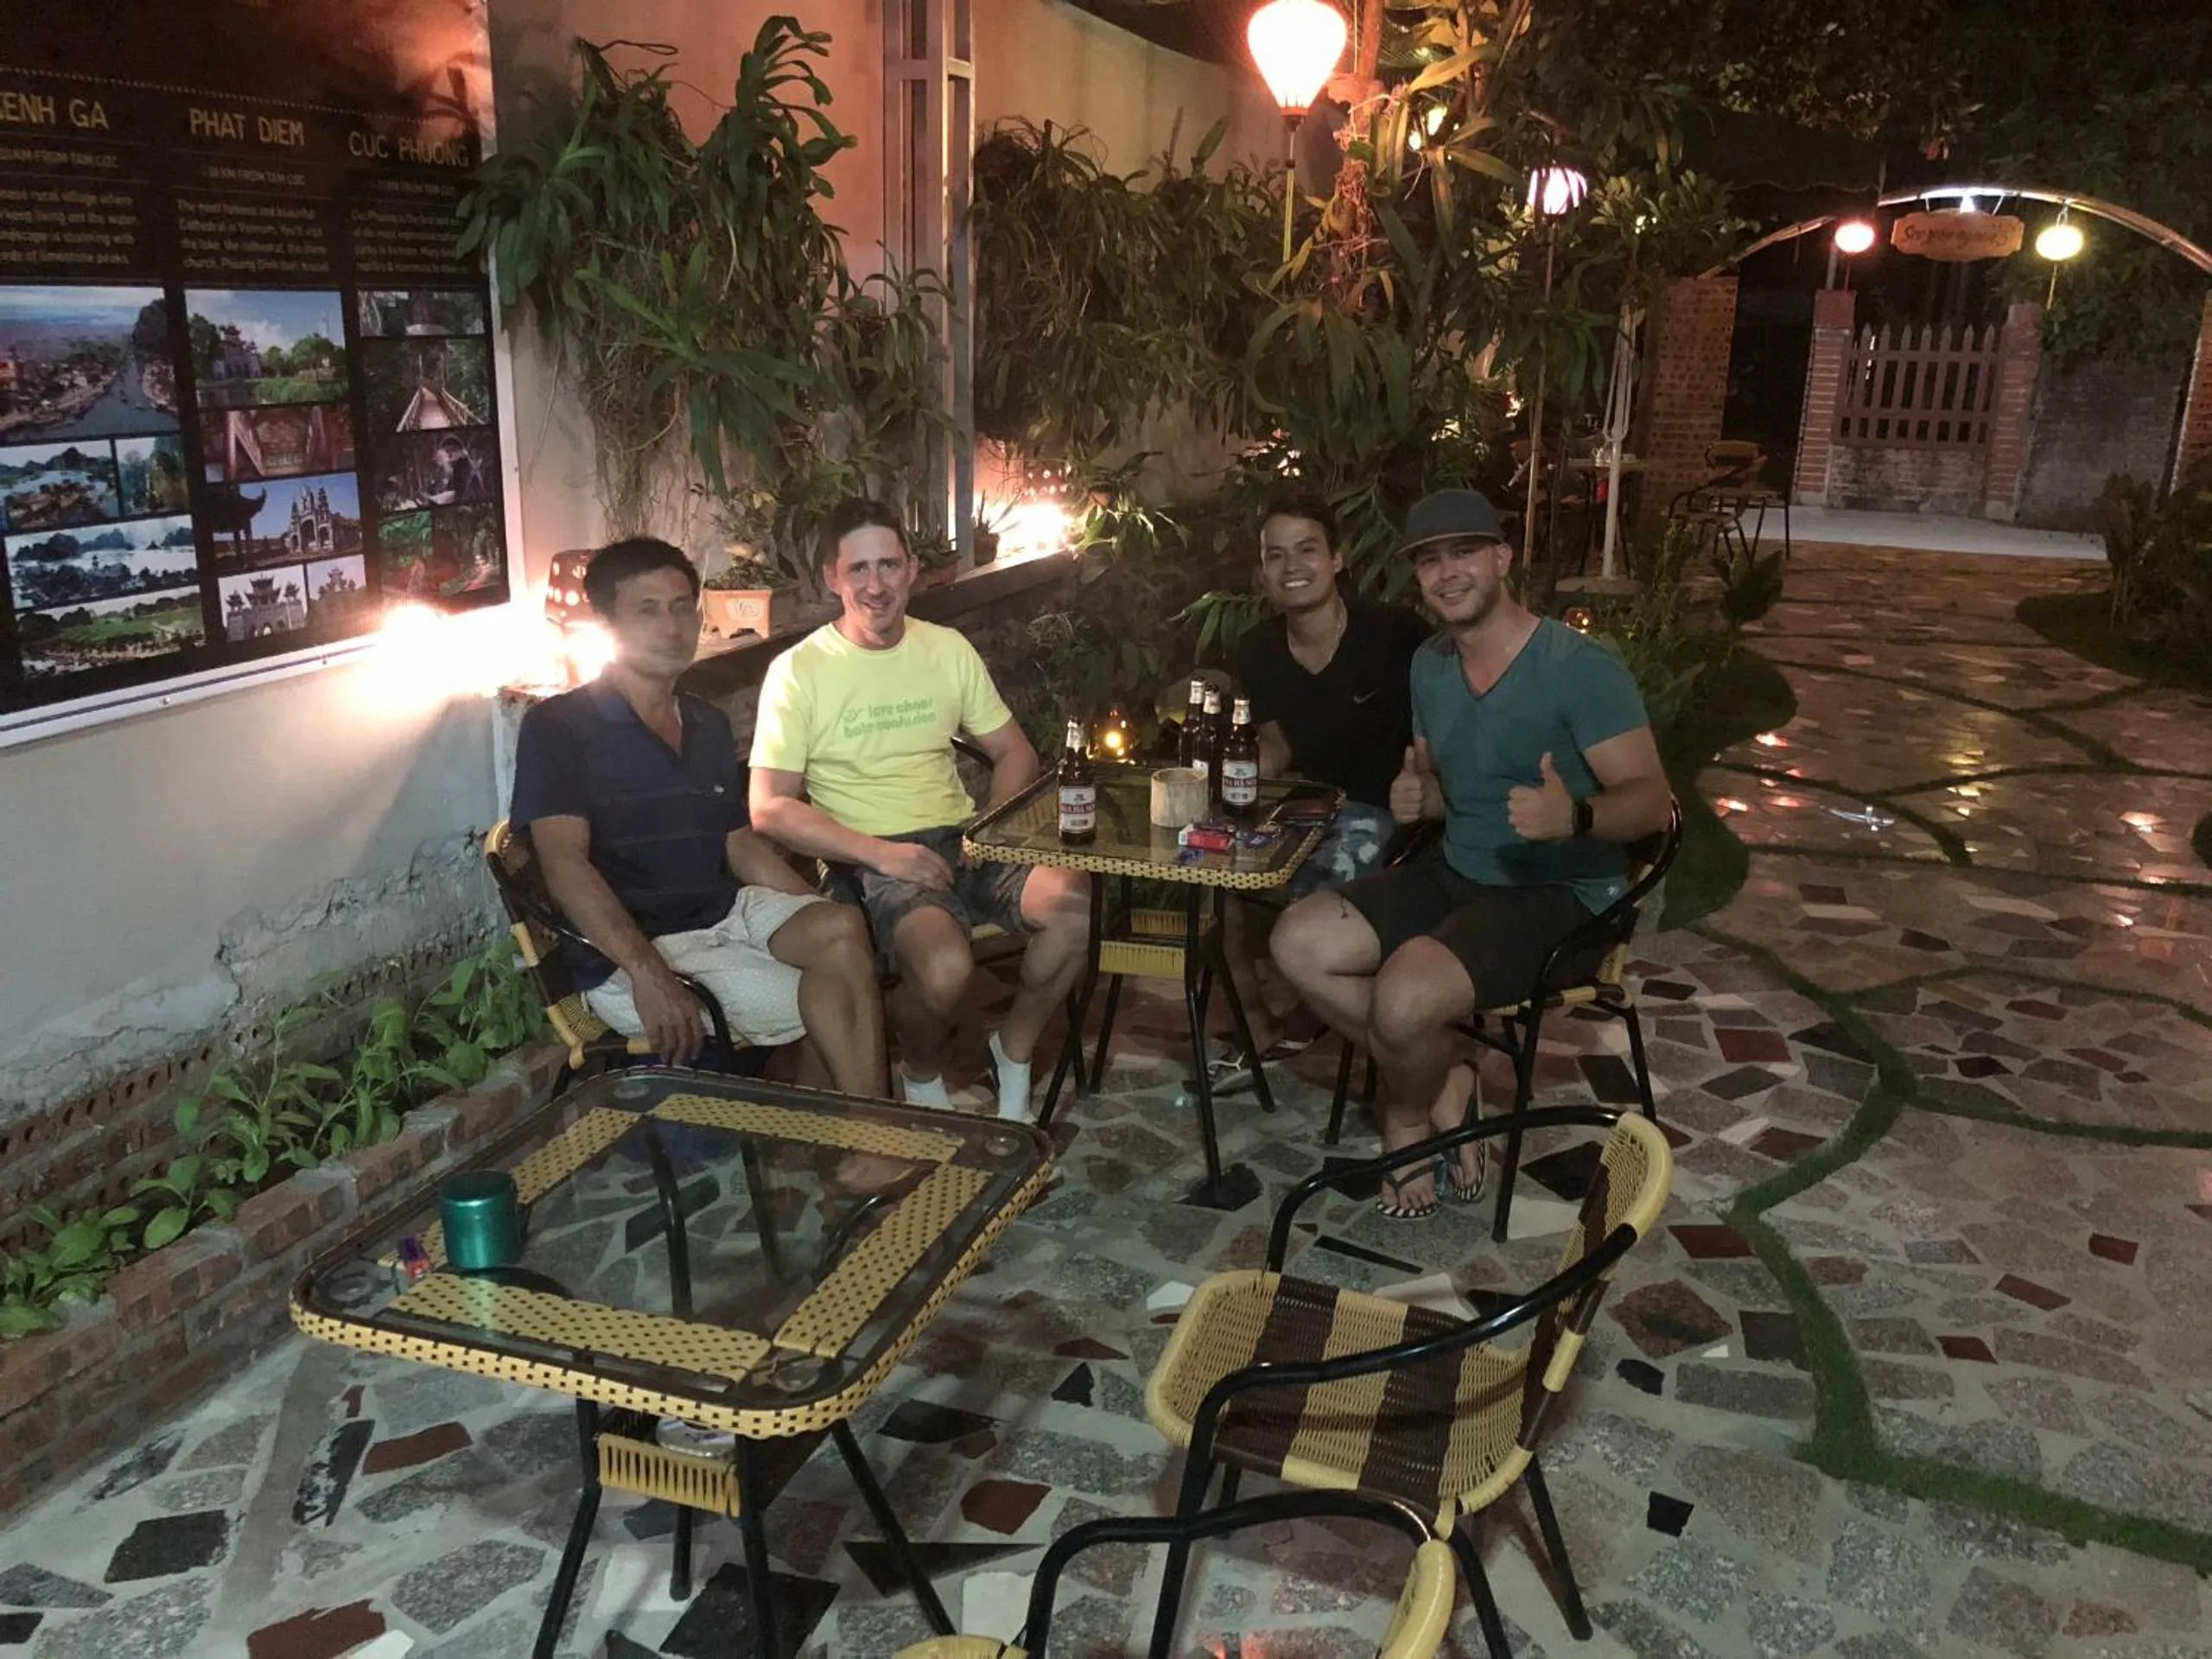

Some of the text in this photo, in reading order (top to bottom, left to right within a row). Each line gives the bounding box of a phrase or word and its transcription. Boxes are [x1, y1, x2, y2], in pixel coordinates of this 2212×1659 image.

[0, 91, 110, 130] ENH GA
[188, 108, 305, 146] PHAT DIEM
[349, 131, 470, 168] CUC PHUONG
